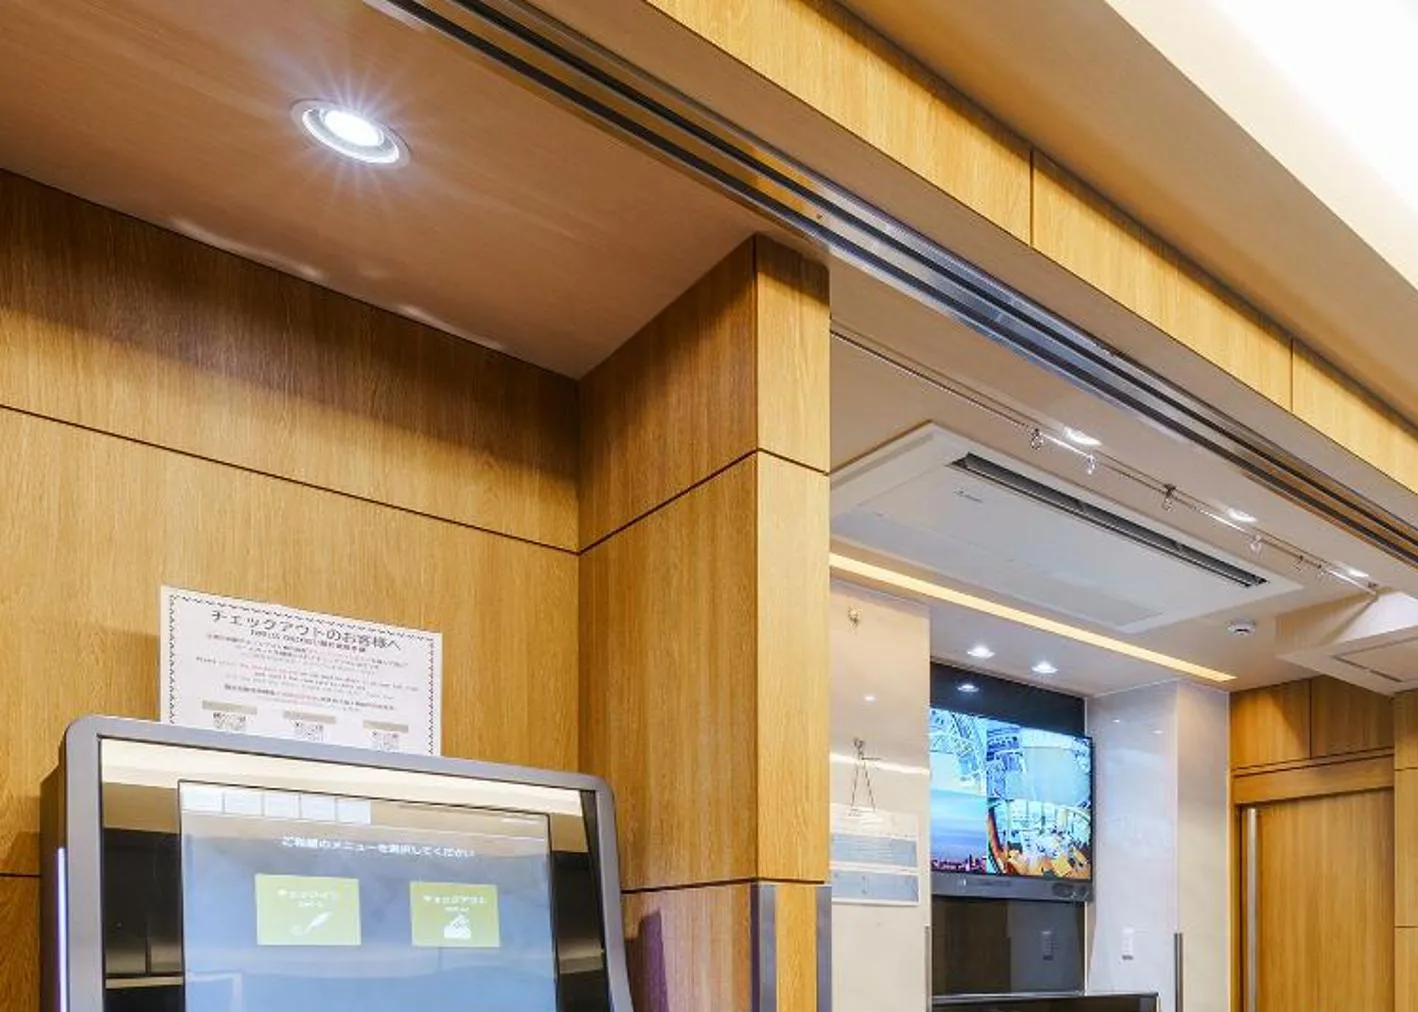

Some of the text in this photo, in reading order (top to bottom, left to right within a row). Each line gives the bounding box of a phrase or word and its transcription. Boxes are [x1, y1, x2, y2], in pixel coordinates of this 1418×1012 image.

[211, 610, 401, 650] チェックアウトのお客様へ
